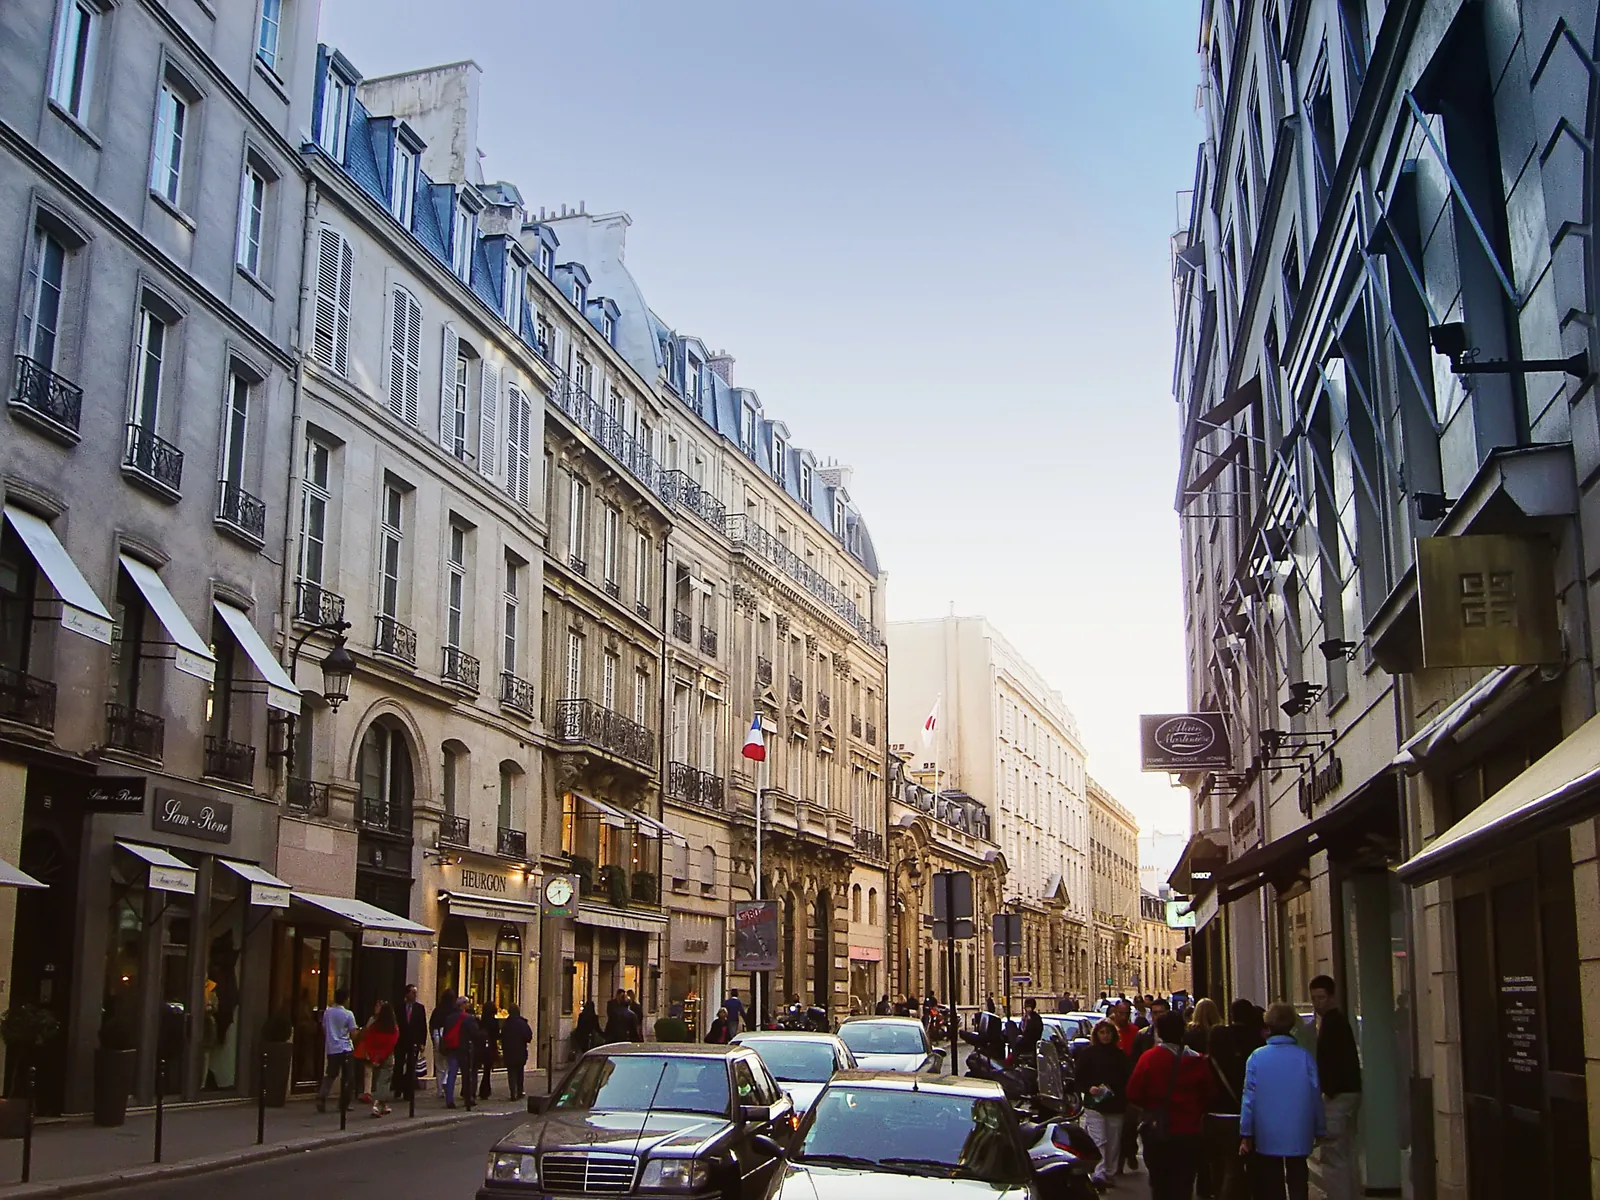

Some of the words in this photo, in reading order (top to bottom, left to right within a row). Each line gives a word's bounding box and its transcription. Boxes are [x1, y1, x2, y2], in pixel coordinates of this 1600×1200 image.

[115, 788, 143, 801] Rone
[162, 799, 189, 826] Sam
[197, 805, 229, 833] Rone
[461, 869, 507, 893] HEURGON
[1177, 1000, 1184, 1010] P
